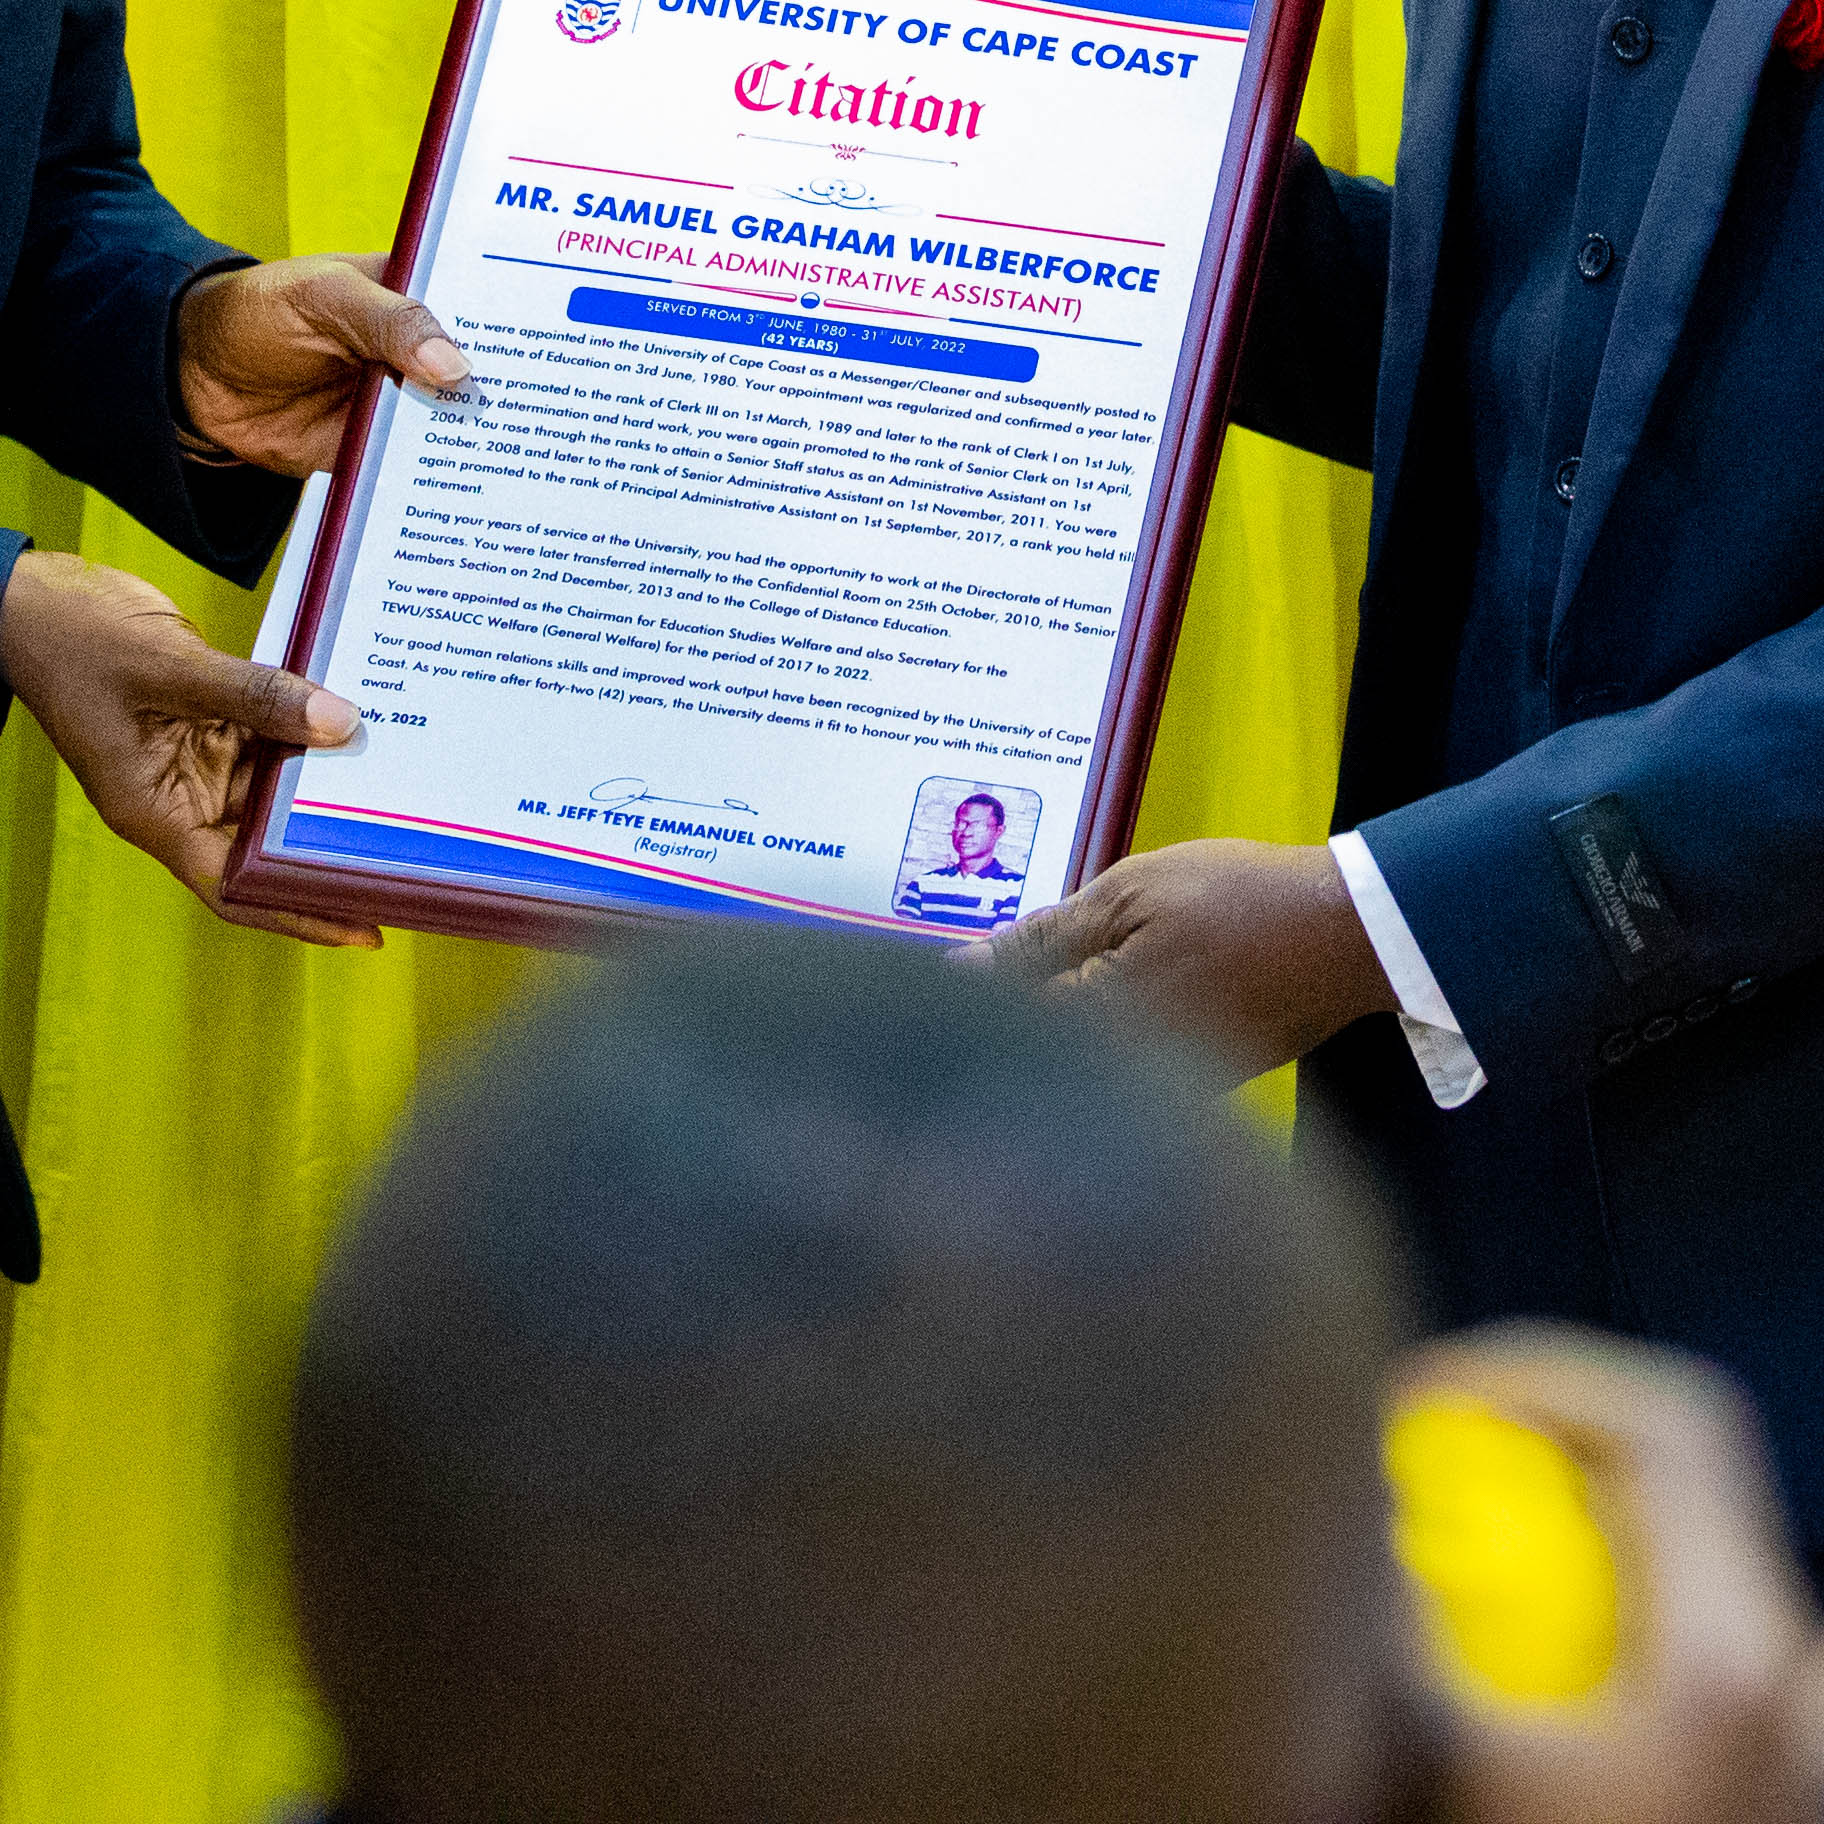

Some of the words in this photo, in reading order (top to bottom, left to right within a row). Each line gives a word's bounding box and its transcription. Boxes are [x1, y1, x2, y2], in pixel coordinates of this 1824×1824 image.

[896, 18, 951, 46] OF
[961, 26, 1059, 62] CAPE
[1070, 40, 1199, 78] COAST
[733, 58, 984, 139] Citation
[494, 181, 559, 213] MR.
[572, 192, 717, 235] SAMUEL
[730, 214, 895, 258] GRAHAM
[909, 236, 1160, 293] WILBERFORCE
[556, 229, 696, 266] (PRINCIPAL
[704, 251, 925, 297] ADMINISTRATIVE
[930, 281, 1081, 323] ASSISTANT)
[646, 299, 697, 317] SERVED
[700, 306, 741, 322] FROM
[814, 322, 847, 337] 1980
[930, 338, 966, 353] 2022
[760, 332, 785, 345] (42
[788, 334, 839, 354] YEARS)
[452, 337, 469, 350] he
[472, 340, 525, 358] Institute
[528, 348, 544, 360] of
[545, 350, 610, 370] Education
[613, 362, 631, 372] on
[634, 362, 659, 376] 3rd
[660, 366, 695, 383] June,
[702, 371, 739, 388] 1980.
[744, 377, 775, 392] Your
[778, 385, 864, 404] appointment
[866, 397, 892, 408] was
[895, 401, 972, 419] regularized
[974, 411, 1002, 423] and
[1004, 416, 1072, 433] confirmed
[1074, 426, 1084, 435] a
[1087, 427, 1118, 439] year
[1120, 428, 1155, 444] later.
[454, 315, 479, 329] You
[482, 322, 515, 334] were
[518, 327, 586, 344] appointed
[588, 337, 615, 348] into
[618, 338, 640, 352] the
[643, 341, 708, 363] University
[710, 351, 726, 363] of
[728, 353, 764, 369] Cape
[767, 359, 806, 374] Coast
[808, 367, 824, 377] as
[827, 370, 837, 379] a
[839, 369, 971, 397] Messenger/Cleaner
[973, 389, 1002, 401] and
[1004, 392, 1091, 415] subsequently
[1093, 406, 1140, 420] posted
[1142, 410, 1157, 422] to
[412, 476, 484, 495] retirement.
[417, 455, 456, 468] again
[458, 461, 525, 478] promoted
[527, 468, 541, 480] to
[544, 470, 566, 484] the
[569, 476, 599, 488] rank
[602, 479, 619, 491] of
[620, 480, 678, 500] Principal
[679, 490, 775, 513] Administrative
[777, 503, 837, 521] Assistant
[839, 514, 858, 524] on
[864, 514, 882, 528] 1st
[885, 517, 960, 540] September,
[965, 529, 1004, 547] 2017,
[1008, 538, 1019, 547] a
[1021, 539, 1053, 552] rank
[1055, 544, 1081, 556] you
[1084, 545, 1115, 560] held
[1118, 550, 1135, 562] till
[393, 548, 455, 567] Members
[458, 556, 507, 575] Section
[509, 567, 528, 577] on
[530, 567, 559, 582] 2nd
[561, 571, 632, 594] December,
[637, 582, 673, 598] 2013
[675, 590, 704, 602] and
[706, 593, 720, 604] to
[723, 594, 745, 608] the
[748, 598, 800, 617] College
[803, 606, 819, 618] of
[820, 608, 879, 627] Distance
[882, 616, 951, 638] Education.
[399, 526, 468, 547] Resources.
[473, 536, 499, 551] You
[502, 543, 535, 556] were
[538, 545, 570, 560] later
[572, 551, 646, 571] transferred
[648, 561, 712, 583] internally
[714, 571, 728, 583] to
[731, 573, 753, 587] the
[756, 576, 840, 599] Confidential
[841, 588, 881, 605] Room
[883, 597, 902, 608] on
[905, 597, 937, 612] 25th
[940, 602, 998, 623] October,
[1003, 611, 1042, 629] 2010,
[1047, 617, 1070, 631] the
[1073, 621, 1116, 637] Senior
[381, 599, 484, 626] TEWU/SSAUCC
[487, 615, 539, 634] Welfare
[541, 623, 601, 642] (General
[604, 632, 661, 653] Welfare)
[664, 640, 684, 654] for
[687, 644, 709, 658] the
[711, 650, 757, 664] period
[758, 654, 775, 667] of
[776, 656, 813, 672] 2017
[815, 663, 830, 675] to
[833, 664, 872, 682] 2022.
[358, 707, 386, 723] uly,
[389, 711, 427, 727] 2022
[360, 678, 406, 692] award.
[373, 631, 404, 646] Your
[406, 639, 443, 652] good
[444, 641, 492, 659] human
[495, 650, 553, 668] relations
[556, 658, 588, 673] skills
[591, 665, 619, 677] and
[621, 667, 686, 686] improved
[688, 679, 721, 692] work
[724, 685, 769, 699] output
[771, 687, 805, 704] have
[807, 693, 842, 709] been
[845, 702, 920, 720] recognized
[922, 709, 940, 725] by
[942, 713, 965, 727] the
[968, 716, 1035, 739] University
[1037, 727, 1053, 739] of
[1055, 729, 1092, 745] Cape
[516, 798, 551, 816] MR.
[556, 804, 598, 822] JEFF
[601, 809, 645, 829] TEYE
[648, 816, 756, 846] EMMANUEL
[761, 834, 846, 859] ONYAME
[633, 835, 717, 863] (Registrar)
